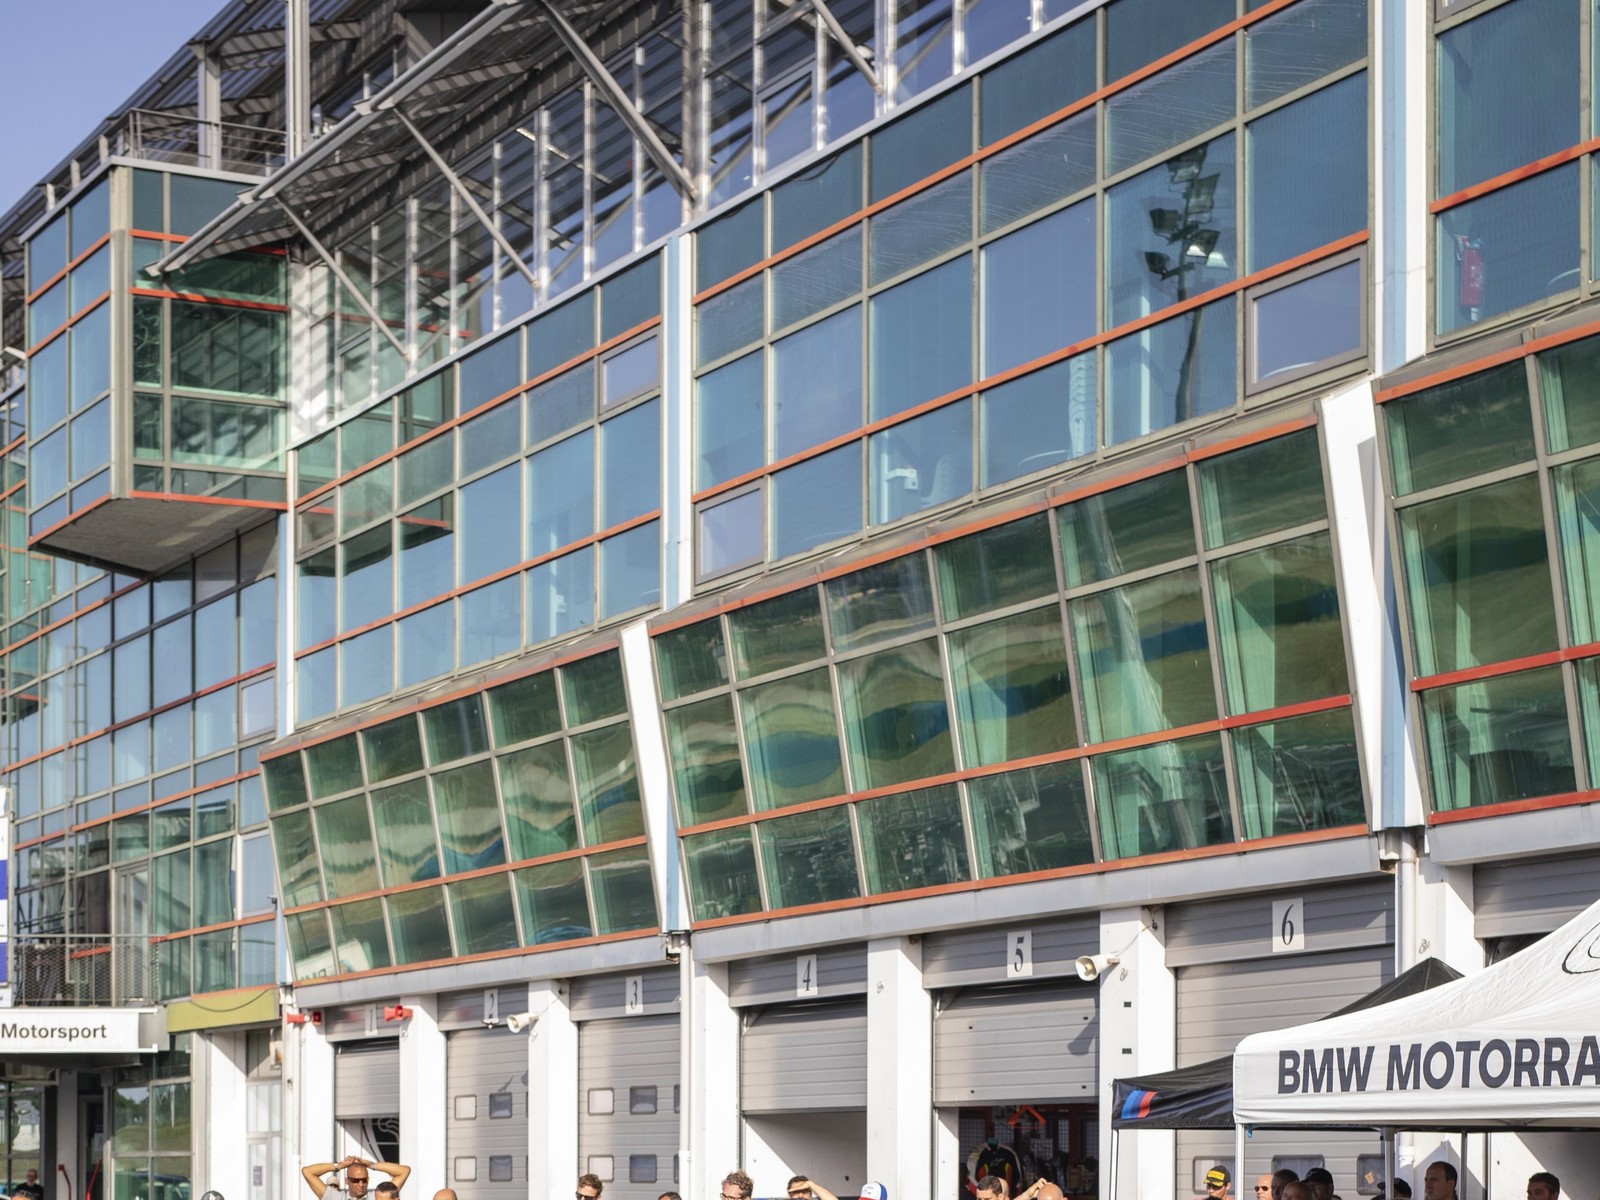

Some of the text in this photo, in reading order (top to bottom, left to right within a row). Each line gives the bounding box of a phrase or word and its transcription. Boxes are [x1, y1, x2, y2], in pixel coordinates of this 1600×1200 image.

[1281, 904, 1294, 945] 6
[1014, 936, 1025, 972] 5
[802, 959, 811, 991] 4
[630, 980, 638, 1010] 3
[1, 1023, 107, 1042] Motorsport
[1278, 1035, 1600, 1094] BMW MOTORRA
